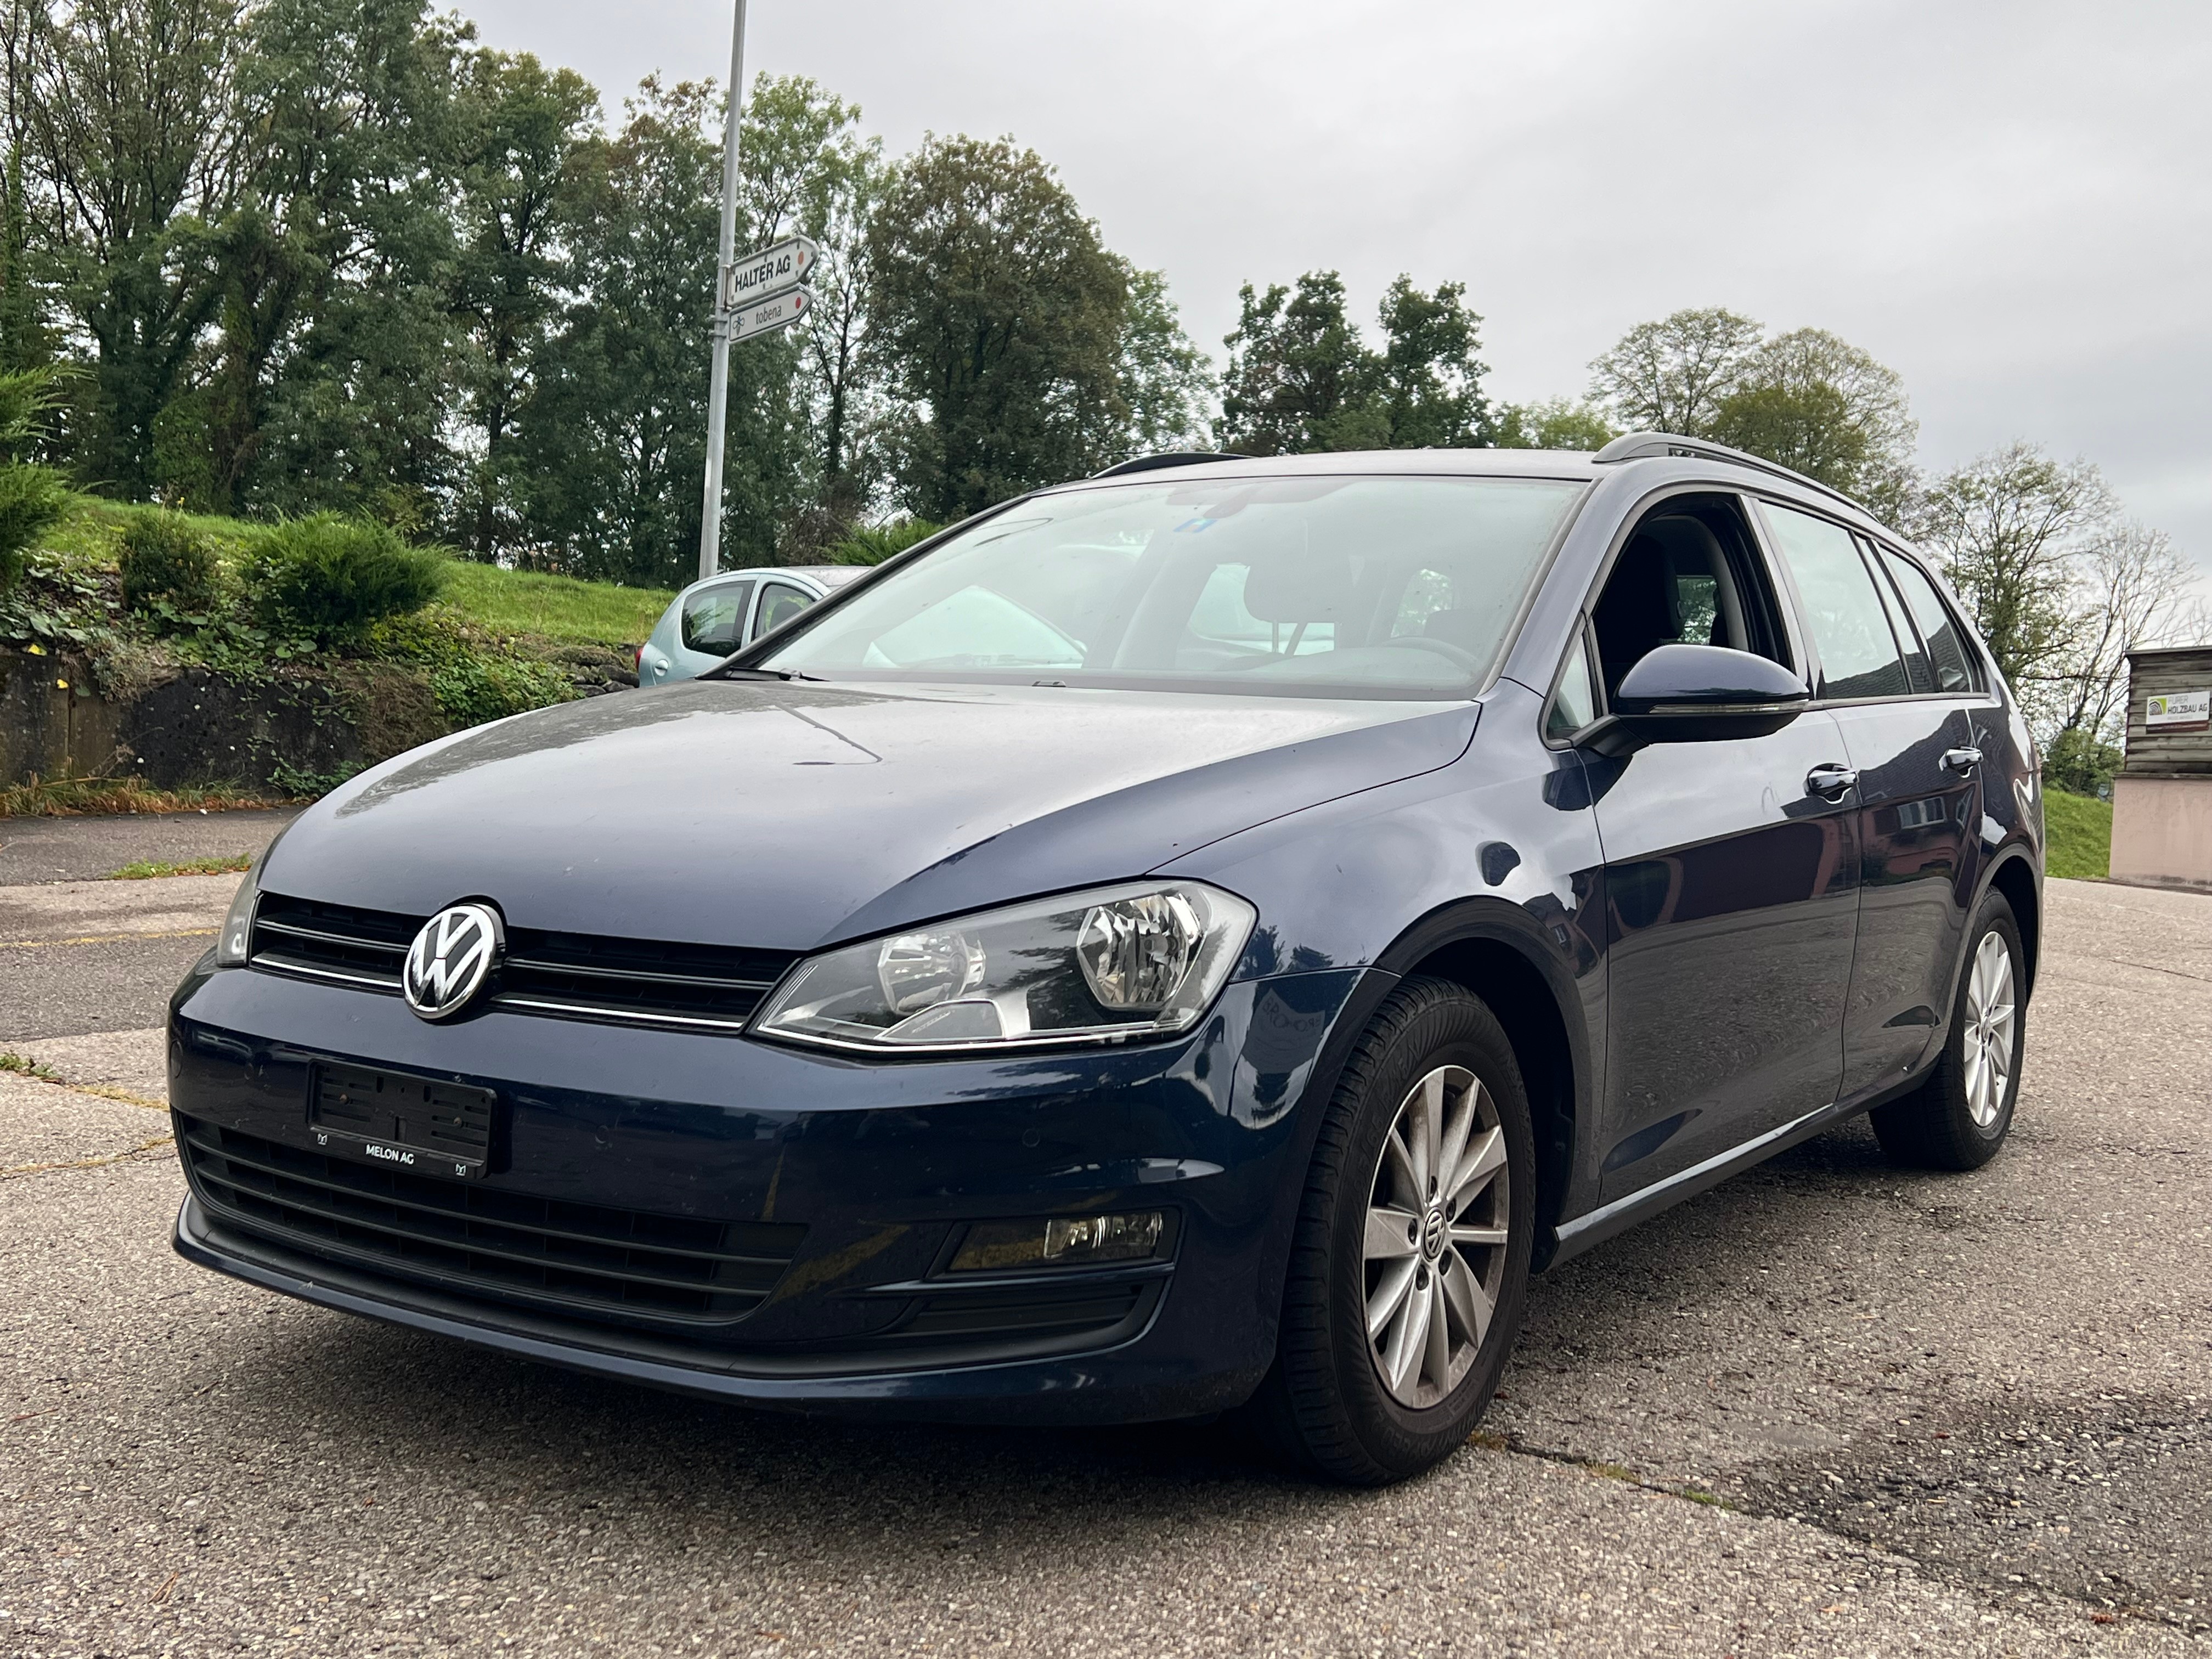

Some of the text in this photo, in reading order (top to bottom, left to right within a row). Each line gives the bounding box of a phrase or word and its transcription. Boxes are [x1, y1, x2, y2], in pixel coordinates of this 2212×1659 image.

[735, 255, 791, 292] HALTER AG
[756, 305, 782, 325] tobena
[2168, 703, 2208, 714] HOLZBAU AG
[366, 1144, 414, 1164] MELON AG
